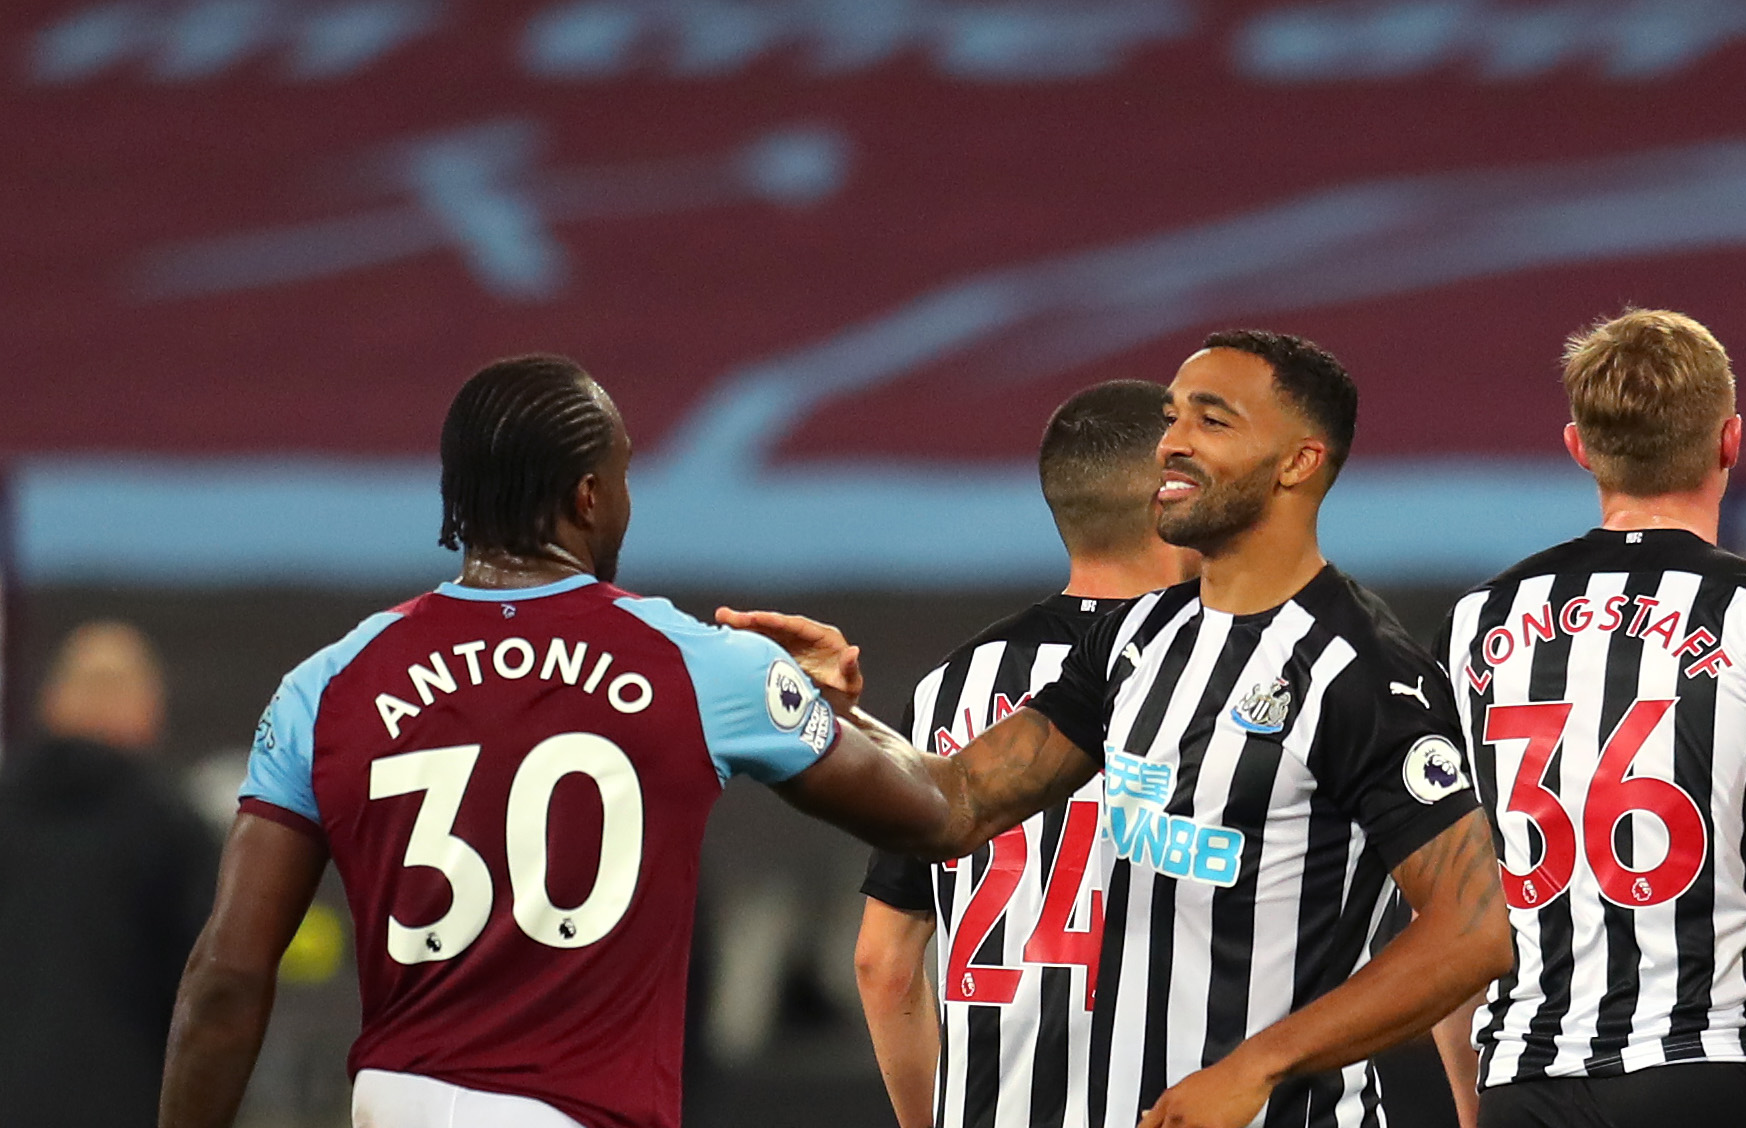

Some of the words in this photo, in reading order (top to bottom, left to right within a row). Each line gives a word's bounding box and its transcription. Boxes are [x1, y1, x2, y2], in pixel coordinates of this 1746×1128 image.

[374, 636, 654, 740] ANTONIO
[1464, 594, 1733, 696] LONGSTAFF
[369, 732, 644, 965] 30
[943, 798, 1105, 1013] 24
[1483, 697, 1707, 910] 36
